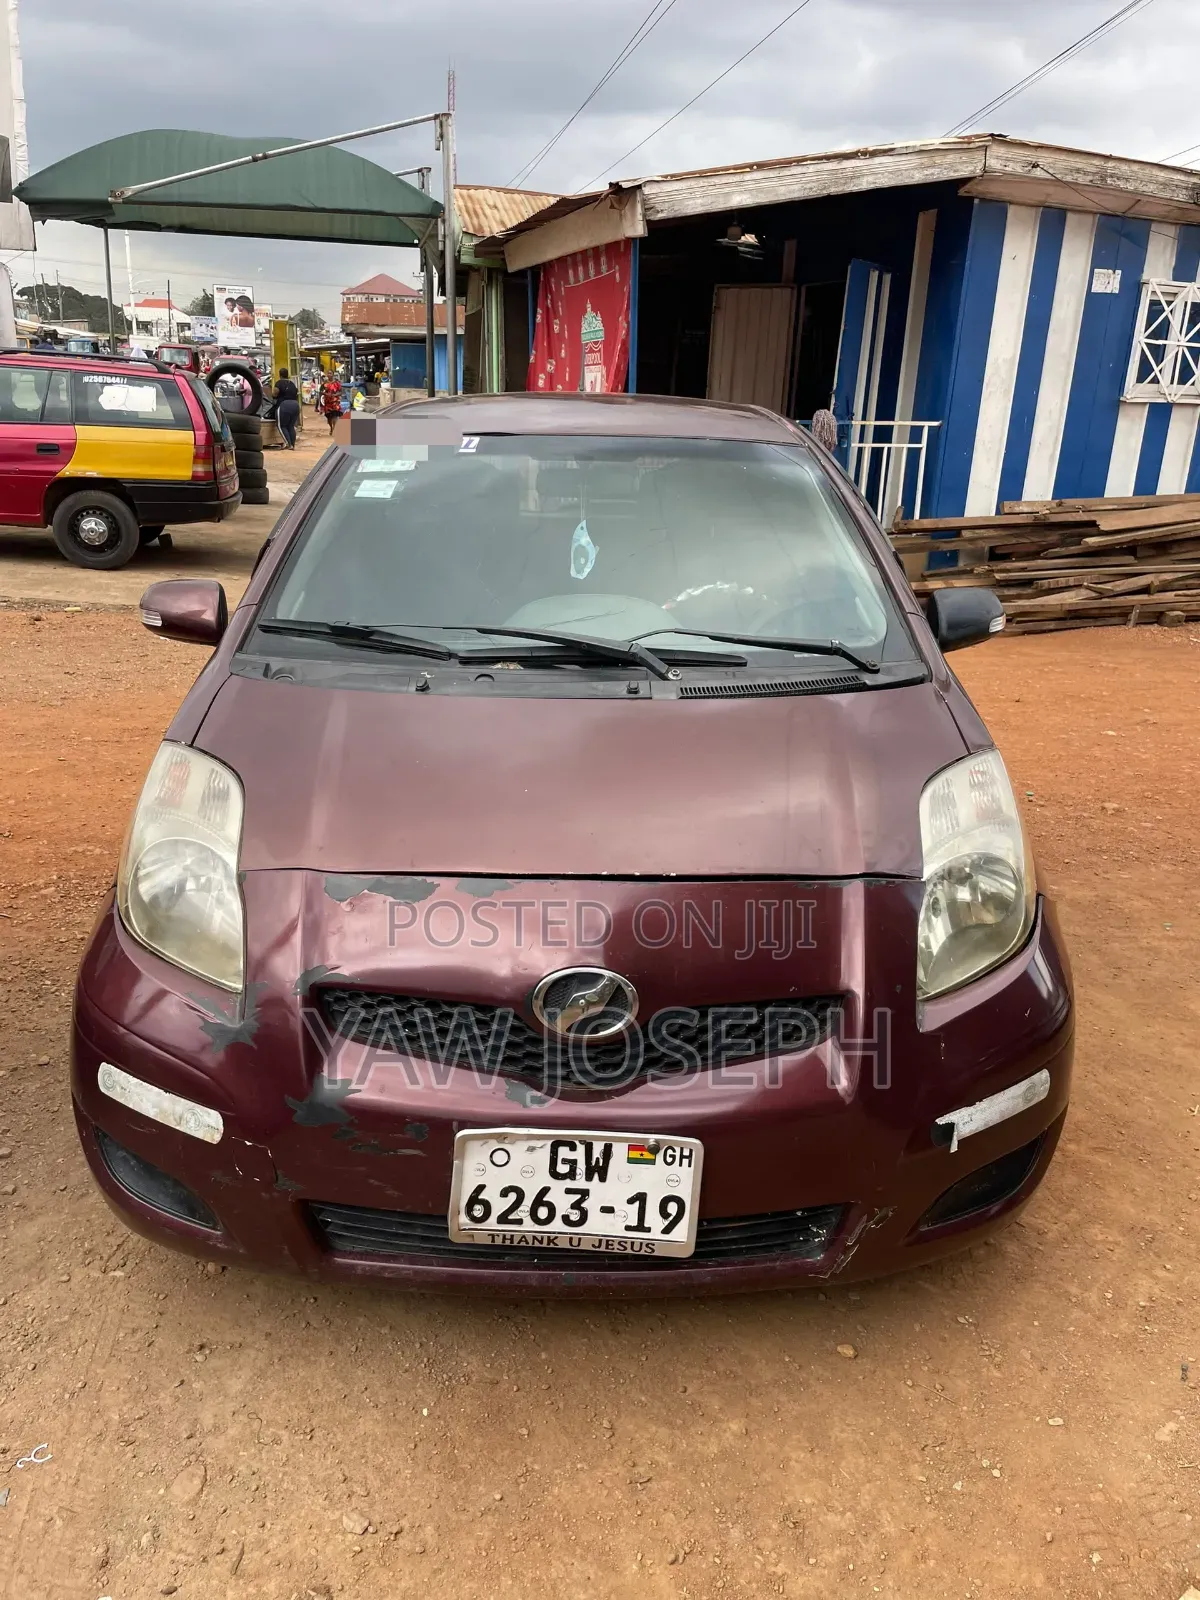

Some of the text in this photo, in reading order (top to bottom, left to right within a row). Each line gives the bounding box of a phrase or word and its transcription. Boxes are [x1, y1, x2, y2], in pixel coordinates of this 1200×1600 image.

[549, 1139, 613, 1183] GW
[662, 1145, 694, 1168] GH
[464, 1183, 686, 1235] 6263-19
[487, 1233, 656, 1254] THANK U JESUS
